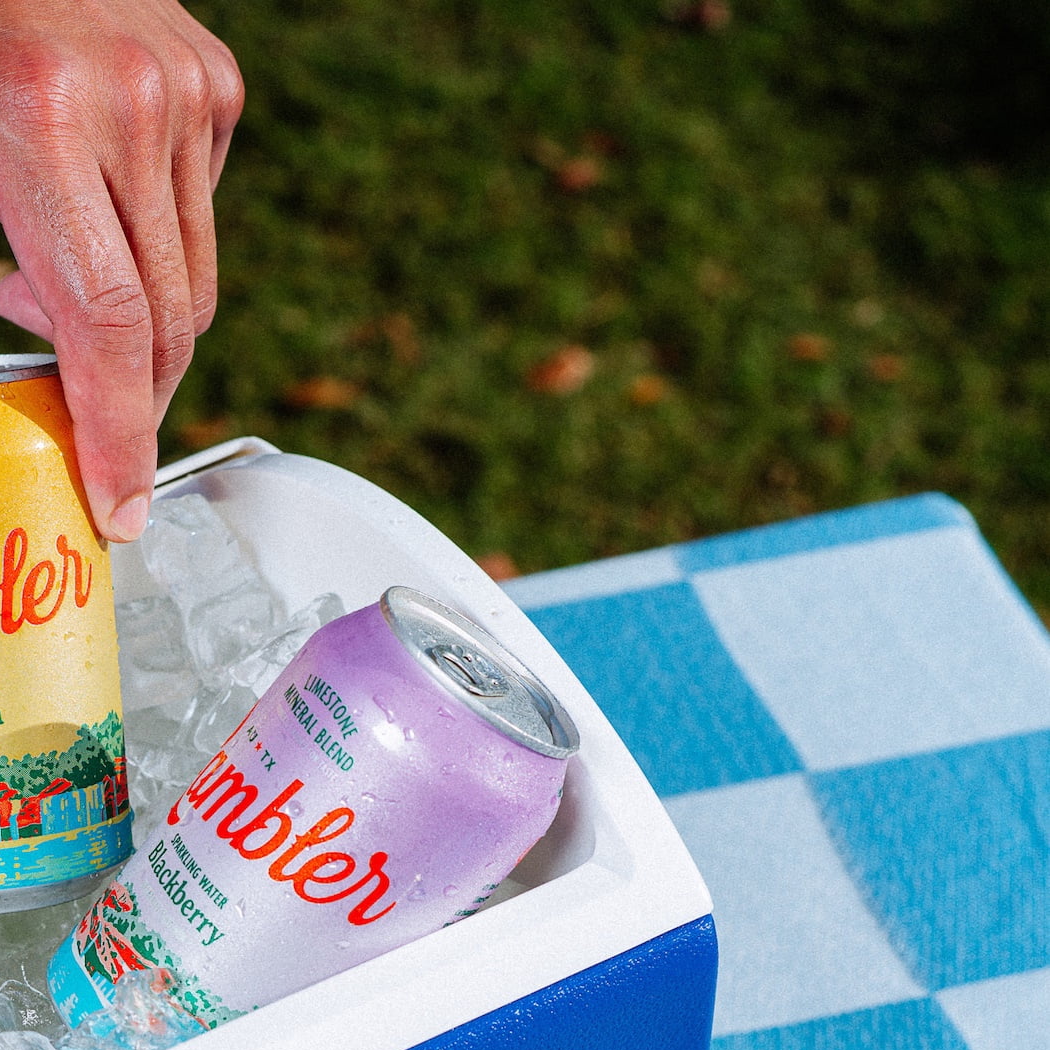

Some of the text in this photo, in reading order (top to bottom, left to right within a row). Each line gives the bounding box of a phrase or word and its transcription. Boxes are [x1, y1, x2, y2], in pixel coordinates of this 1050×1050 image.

[283, 682, 318, 735] MINERAL
[313, 728, 354, 772] BLEND
[303, 673, 358, 740] LIMESTONE
[260, 749, 276, 772] TX
[167, 699, 397, 926] ambler
[148, 839, 225, 946] Blackberry
[170, 833, 229, 910] SPARKLING WATER
